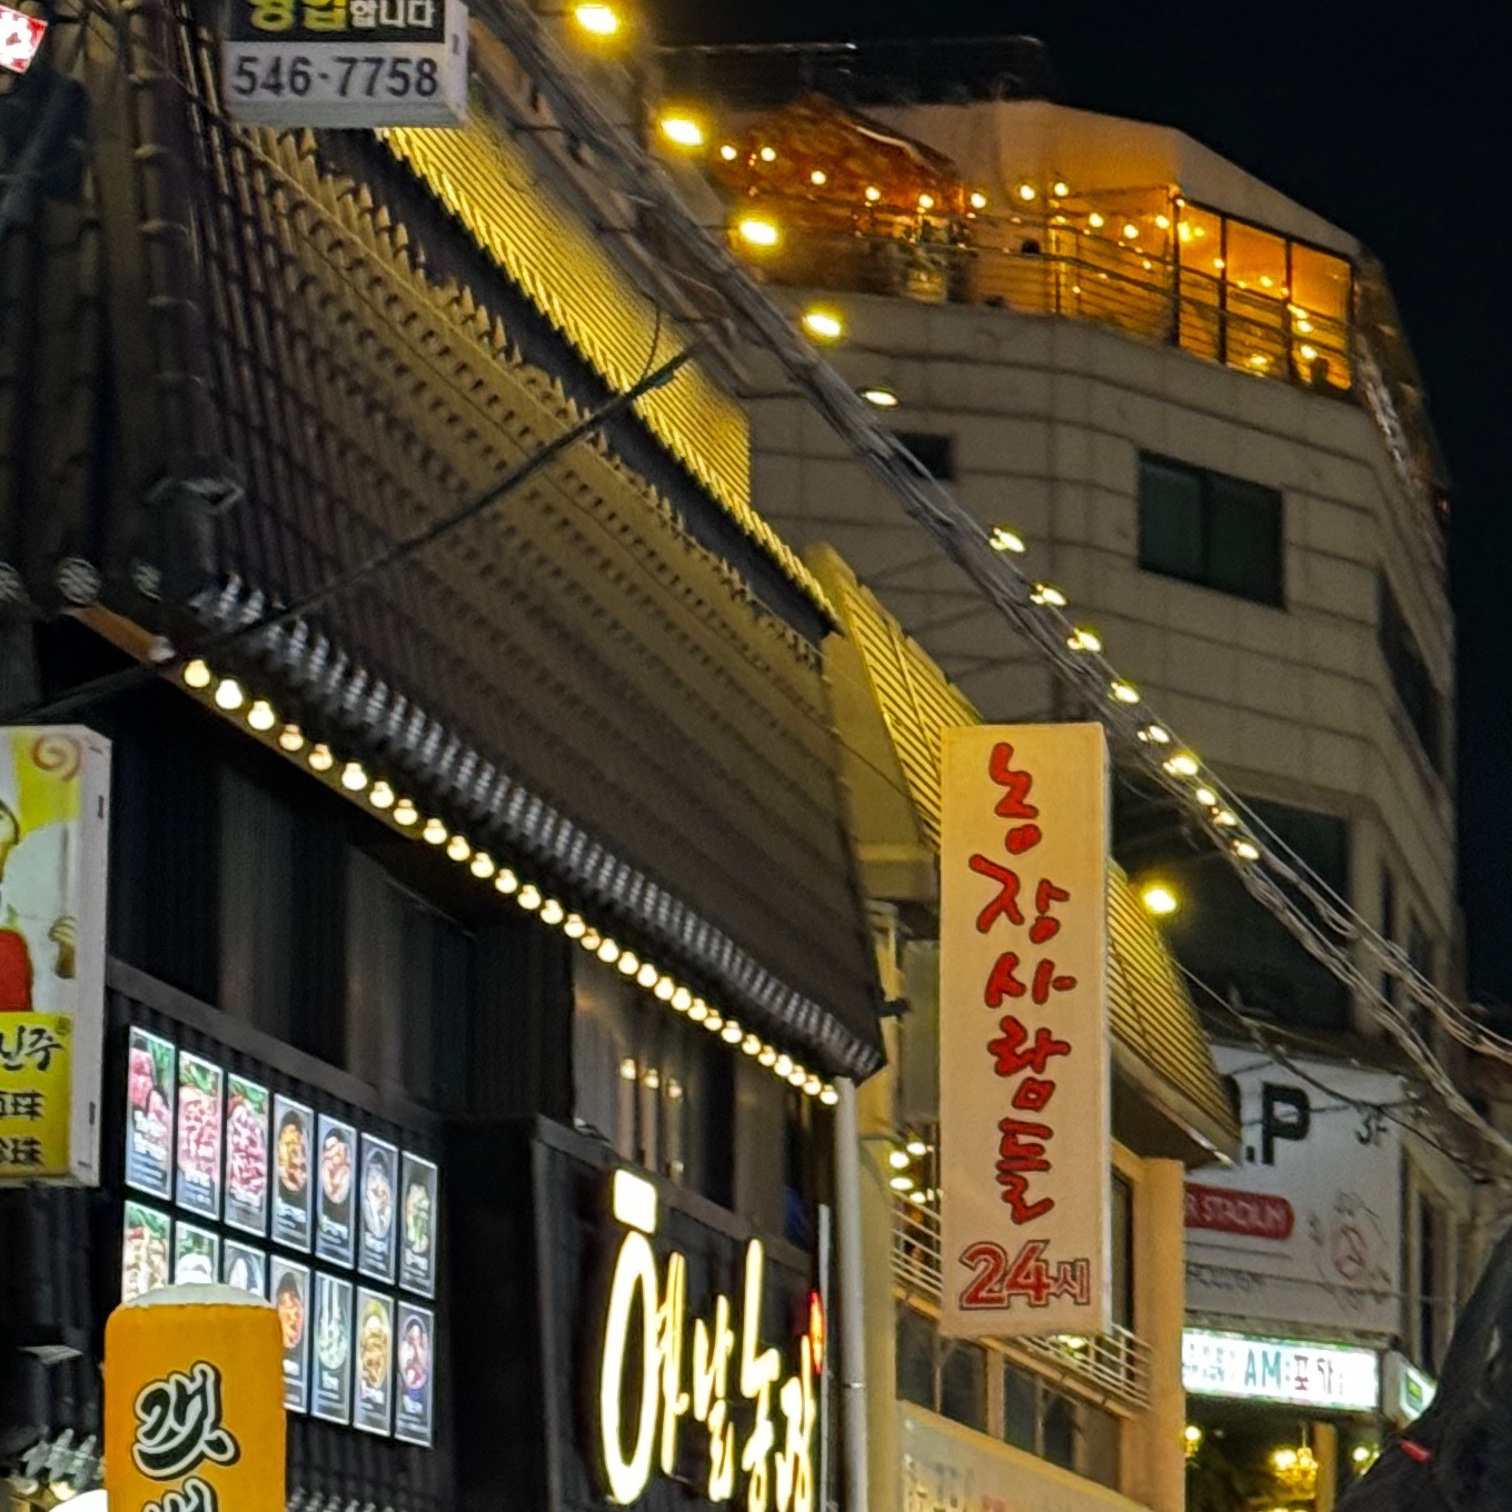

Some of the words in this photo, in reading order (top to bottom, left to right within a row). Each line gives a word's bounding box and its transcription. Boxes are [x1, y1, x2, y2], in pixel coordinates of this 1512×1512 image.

[233, 55, 439, 98] 546-7758
[968, 741, 1078, 1225] 농장사람들
[958, 1238, 1092, 1312] 24시
